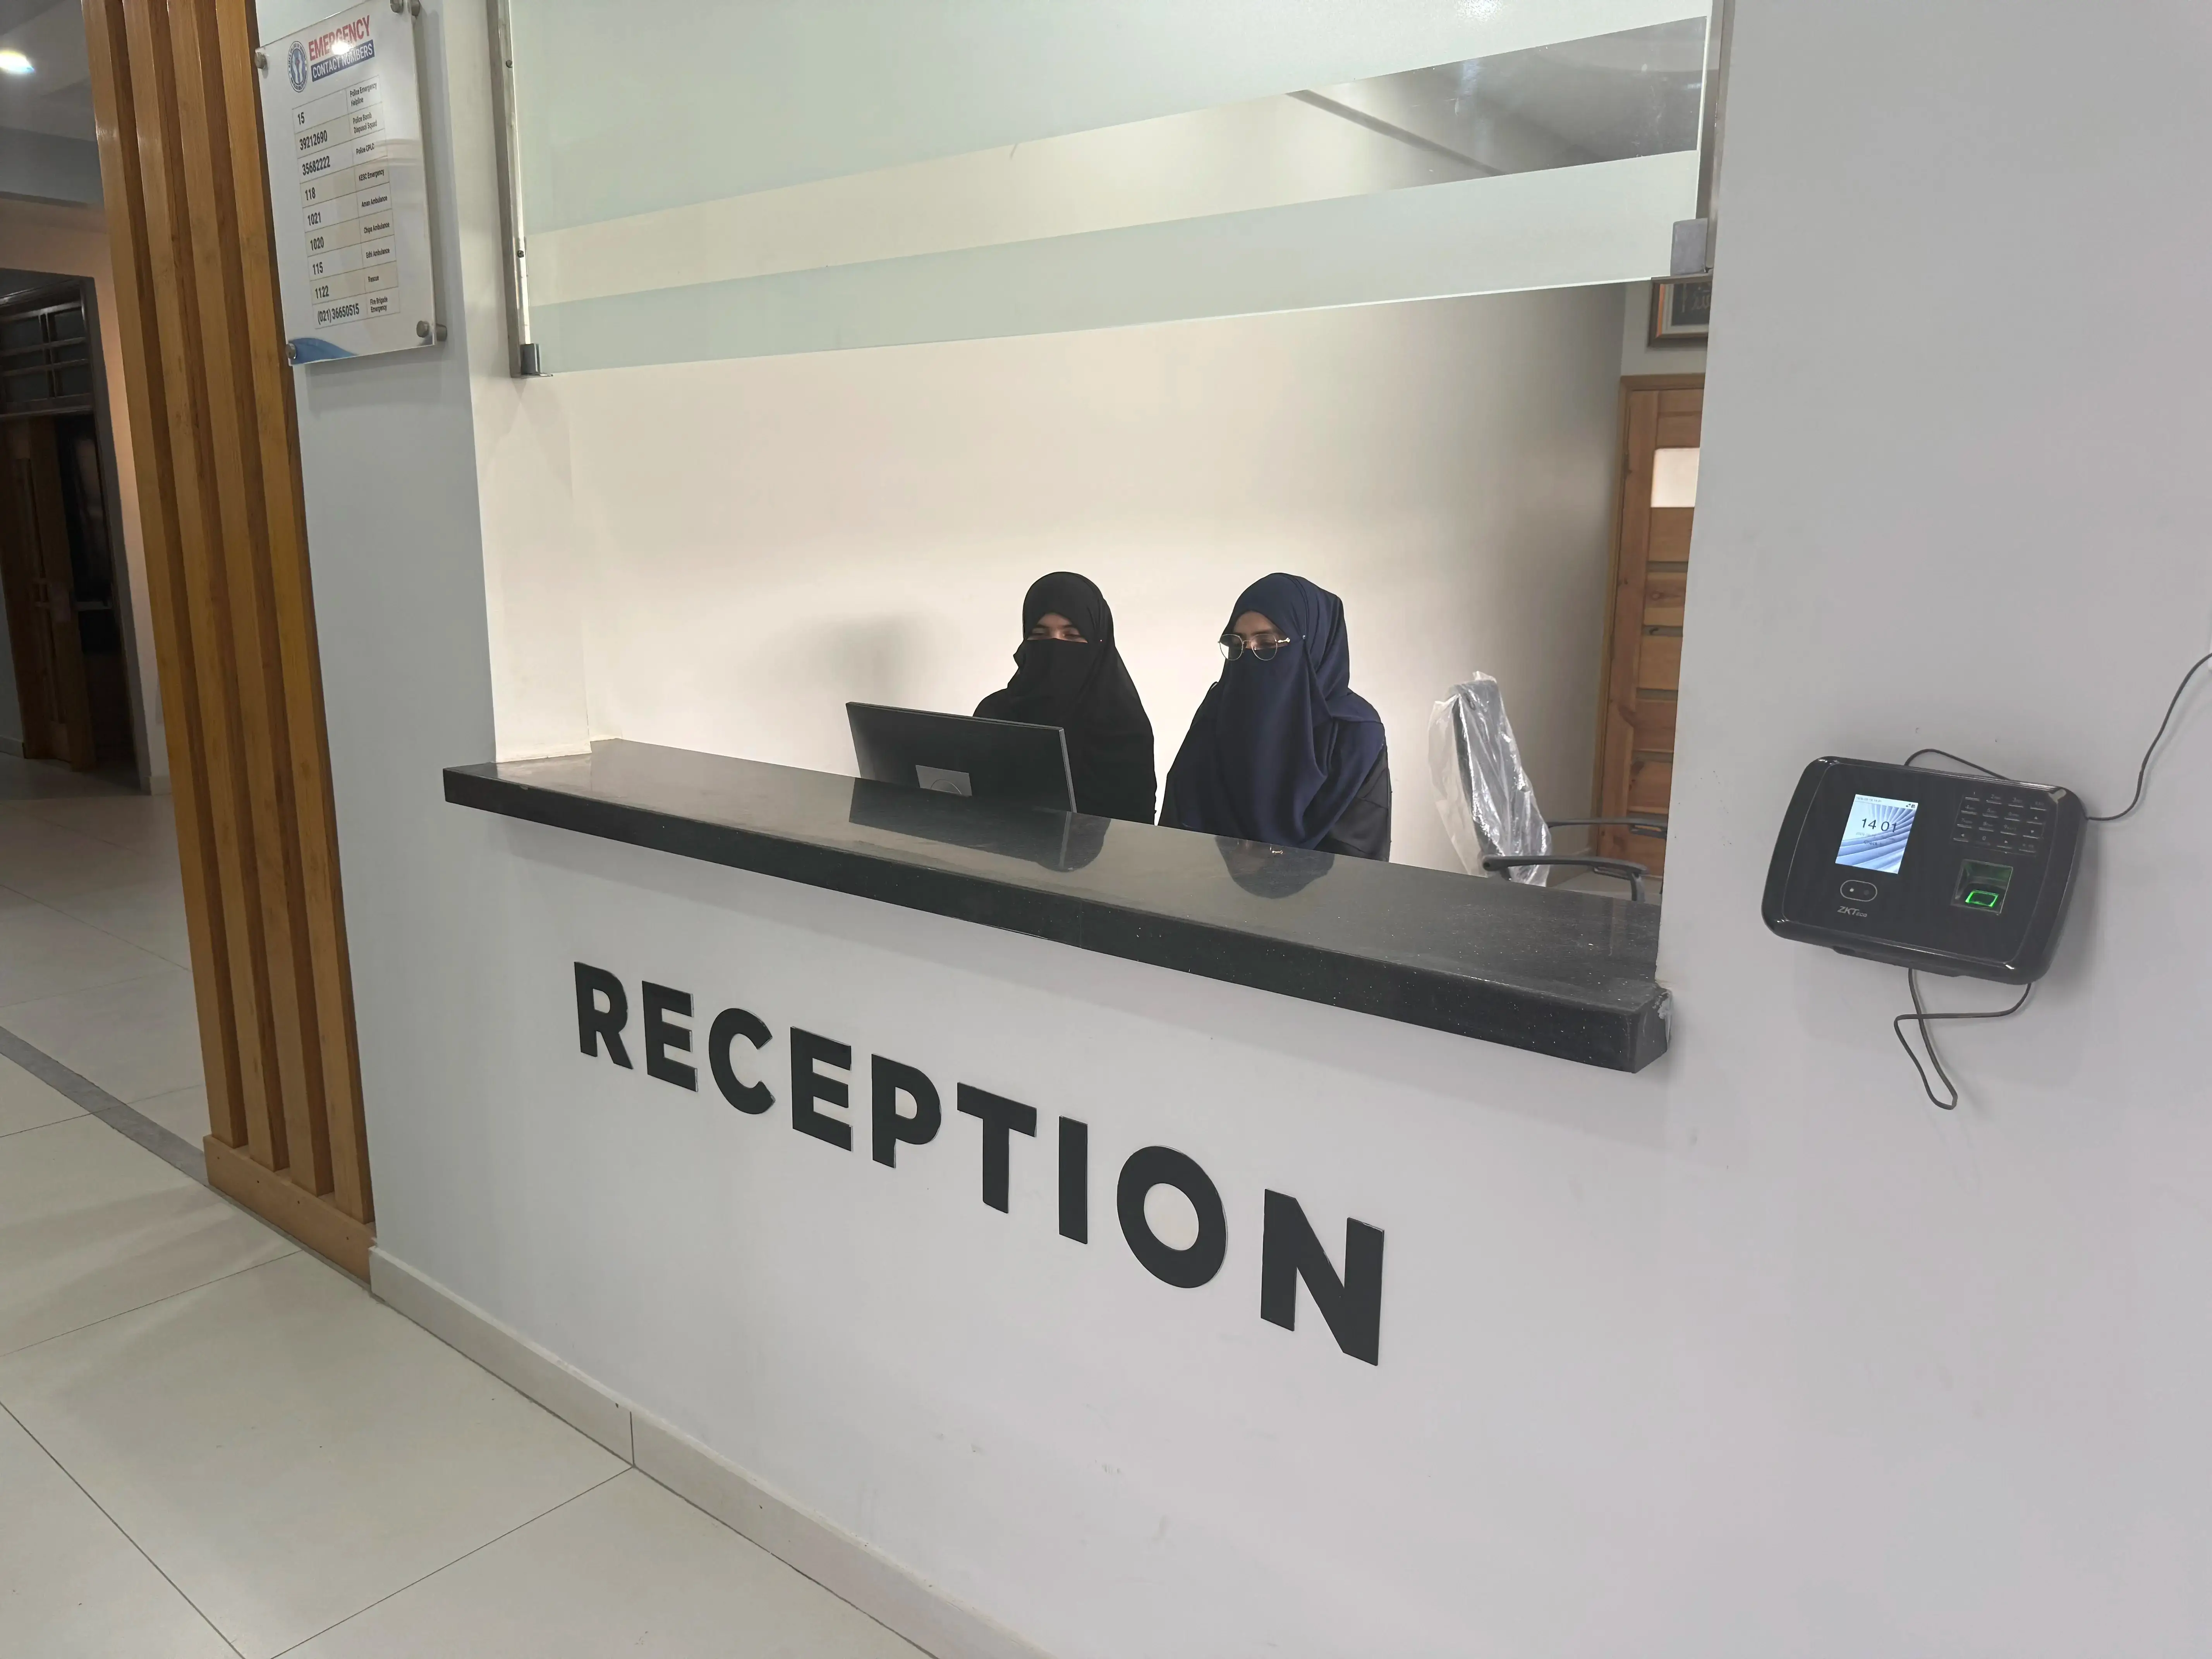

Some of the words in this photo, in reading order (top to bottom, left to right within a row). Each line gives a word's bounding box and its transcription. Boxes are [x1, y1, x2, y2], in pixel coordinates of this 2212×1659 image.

[308, 15, 370, 61] EMERGENCY
[313, 57, 340, 78] CONTACT
[341, 43, 373, 67] NUMBERS
[350, 89, 359, 97] Police
[359, 83, 377, 94] Emergency
[351, 98, 363, 106] Helpline
[297, 112, 305, 125] 15
[299, 130, 328, 151] 39212690
[302, 156, 330, 175] 35682222
[368, 169, 384, 179] Emergency
[305, 187, 316, 201] 118
[371, 196, 388, 205] Ambulance
[307, 212, 321, 226] 1021
[373, 222, 390, 231] Ambulance
[310, 236, 324, 251] 1020
[373, 248, 390, 257] Ambulance
[313, 262, 323, 275] 115
[315, 285, 329, 299] 1122
[376, 296, 388, 305] Brigade
[371, 305, 387, 313] Emergency
[574, 961, 1385, 1367] RECEPTION
